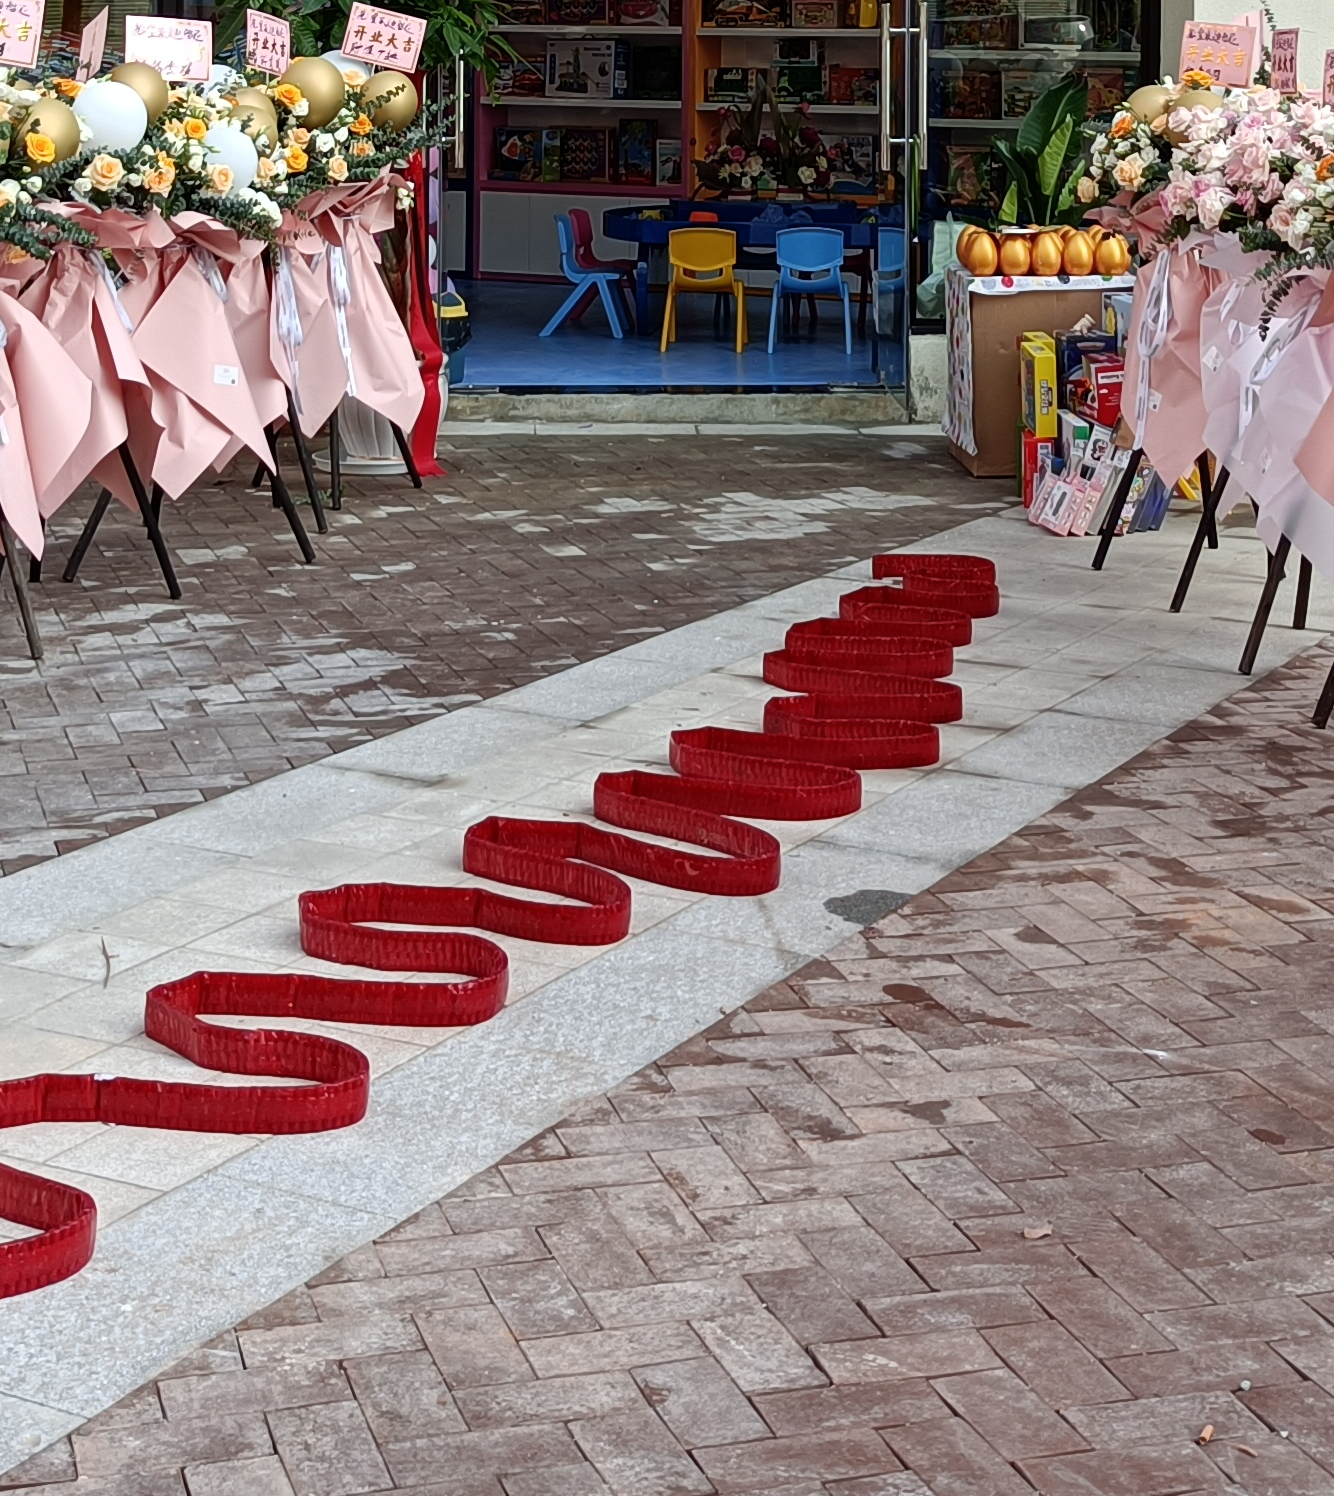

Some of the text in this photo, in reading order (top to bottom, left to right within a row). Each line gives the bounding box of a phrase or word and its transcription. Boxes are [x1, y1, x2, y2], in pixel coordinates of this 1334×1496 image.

[353, 24, 416, 53] 开业大吉
[1186, 43, 1247, 68] 开业大吉
